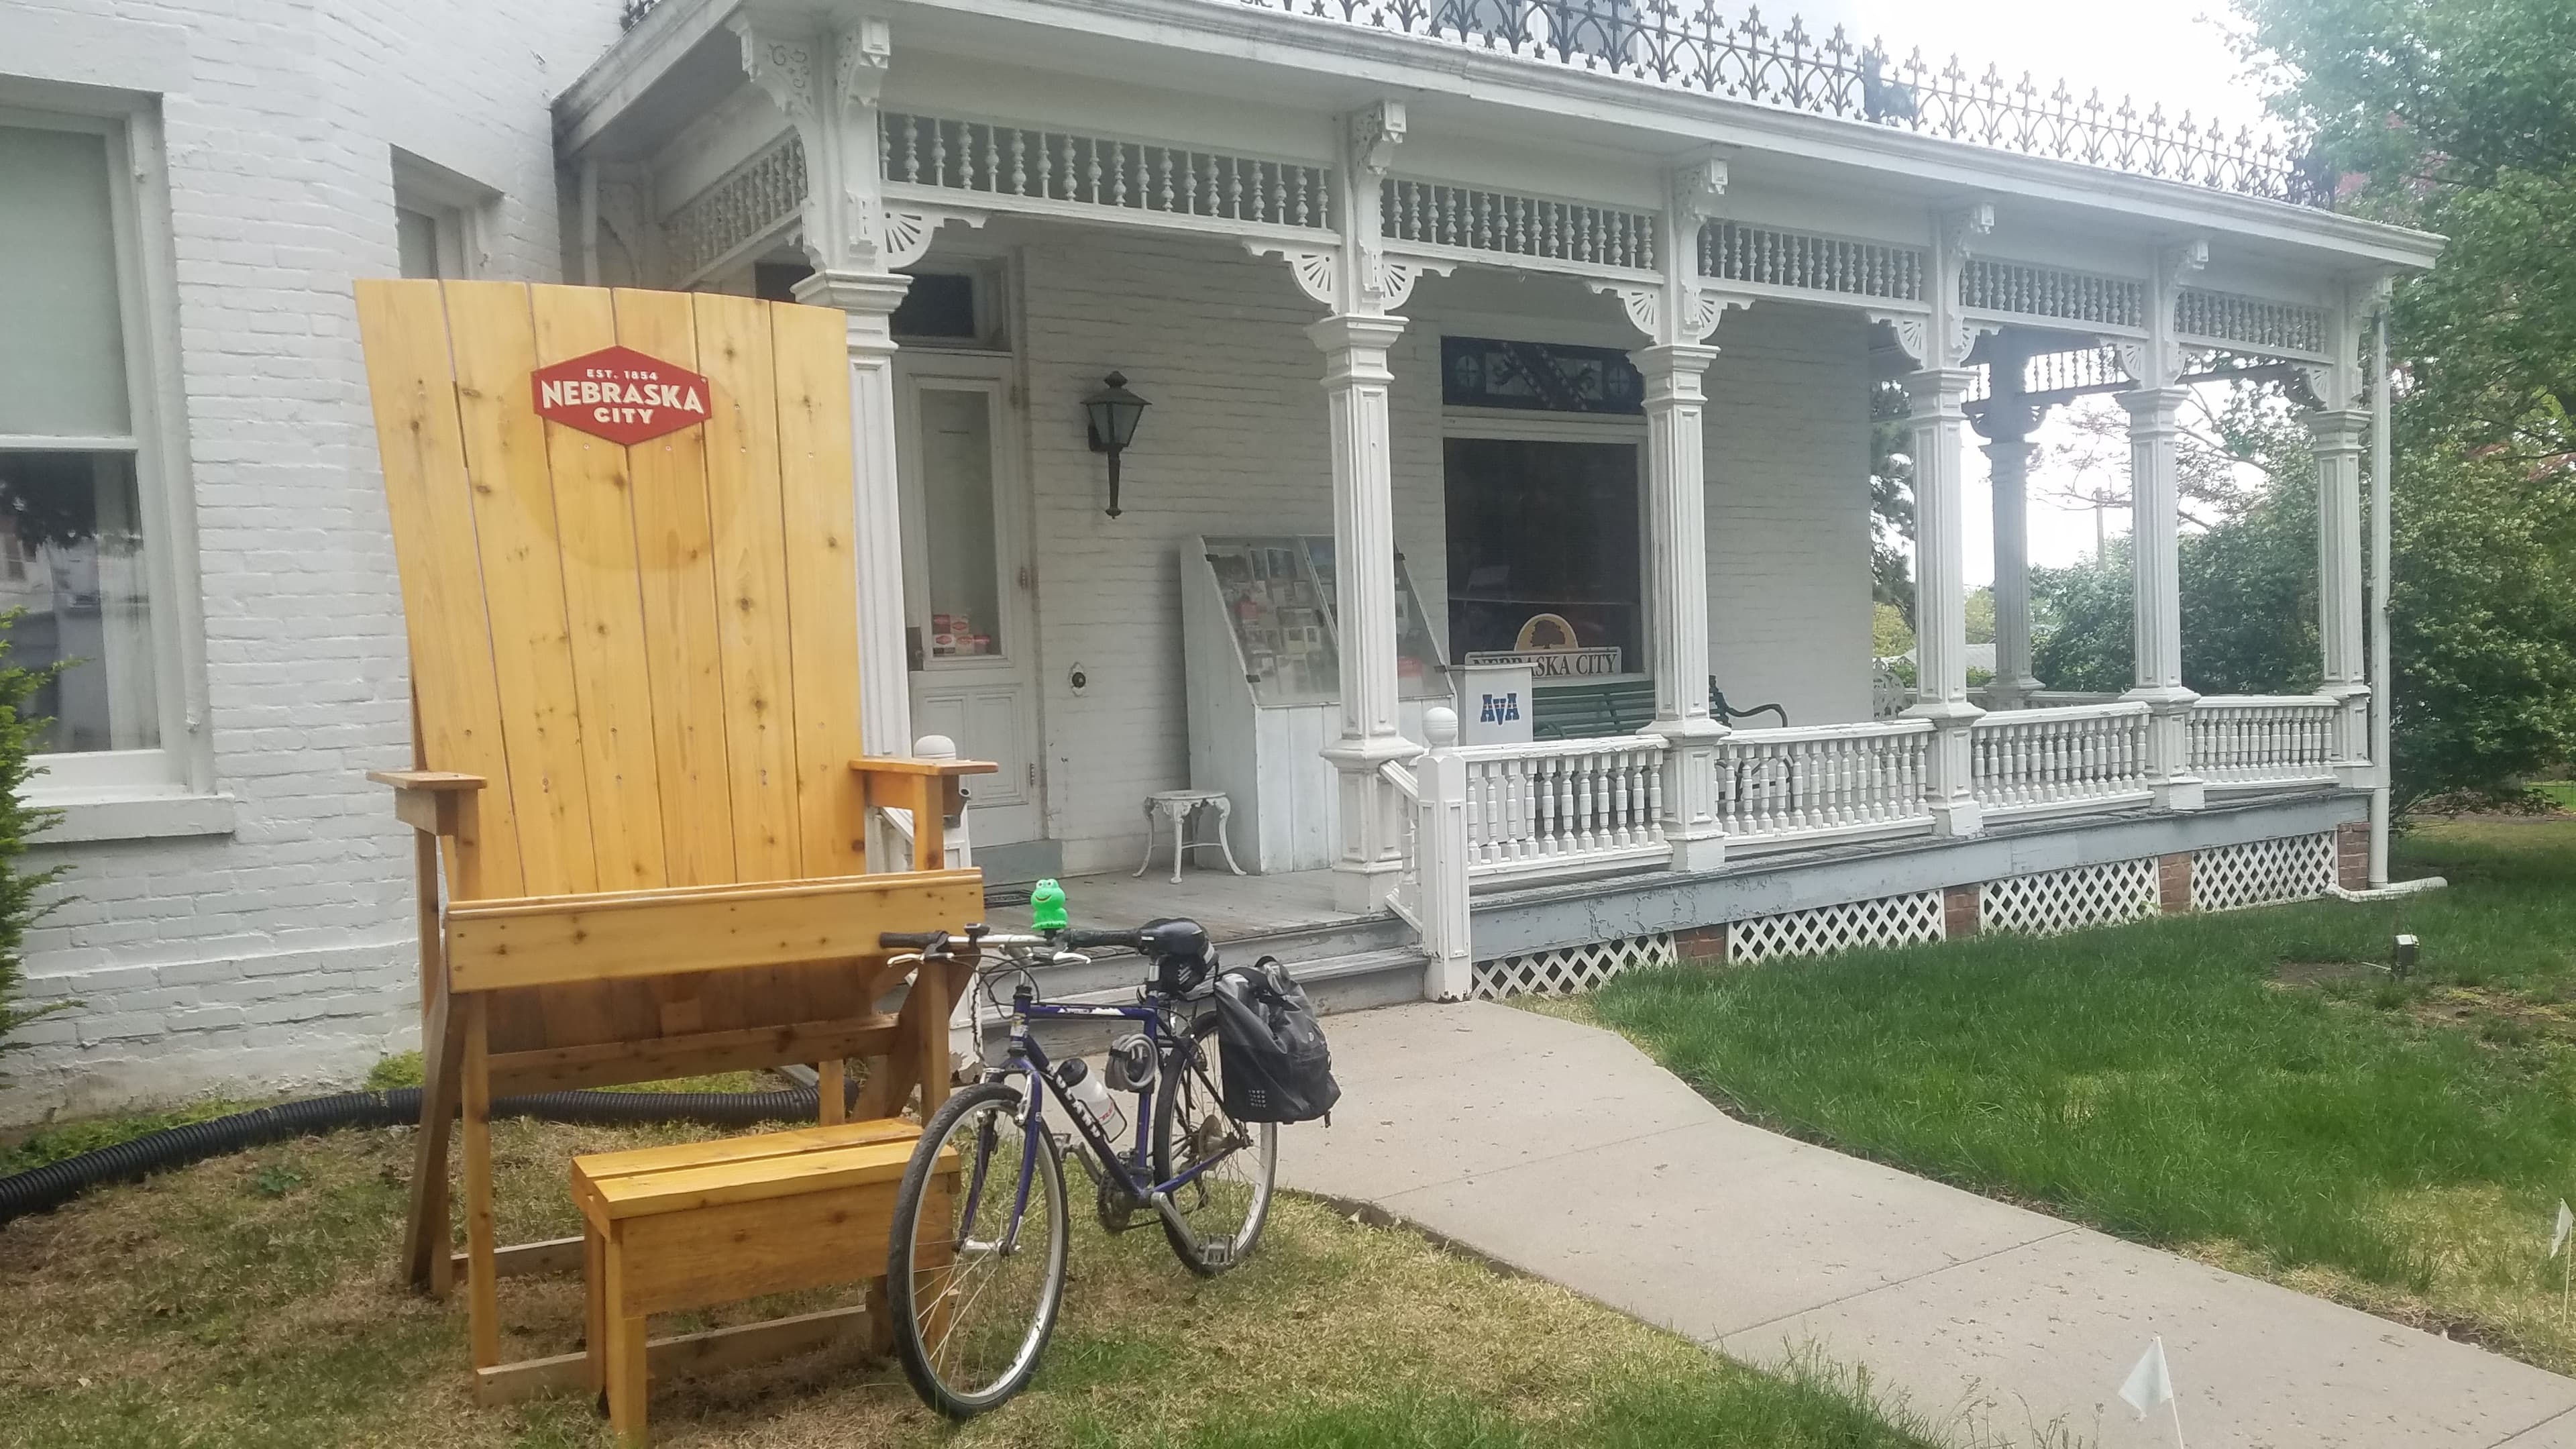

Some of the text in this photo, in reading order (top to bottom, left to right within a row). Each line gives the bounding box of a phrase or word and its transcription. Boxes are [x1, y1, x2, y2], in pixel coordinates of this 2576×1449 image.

[586, 368, 657, 380] EST. 1854
[541, 380, 704, 414] NEBRASKA
[593, 407, 654, 424] CITY
[1576, 653, 1617, 675] CITY
[1480, 692, 1520, 726] AVA
